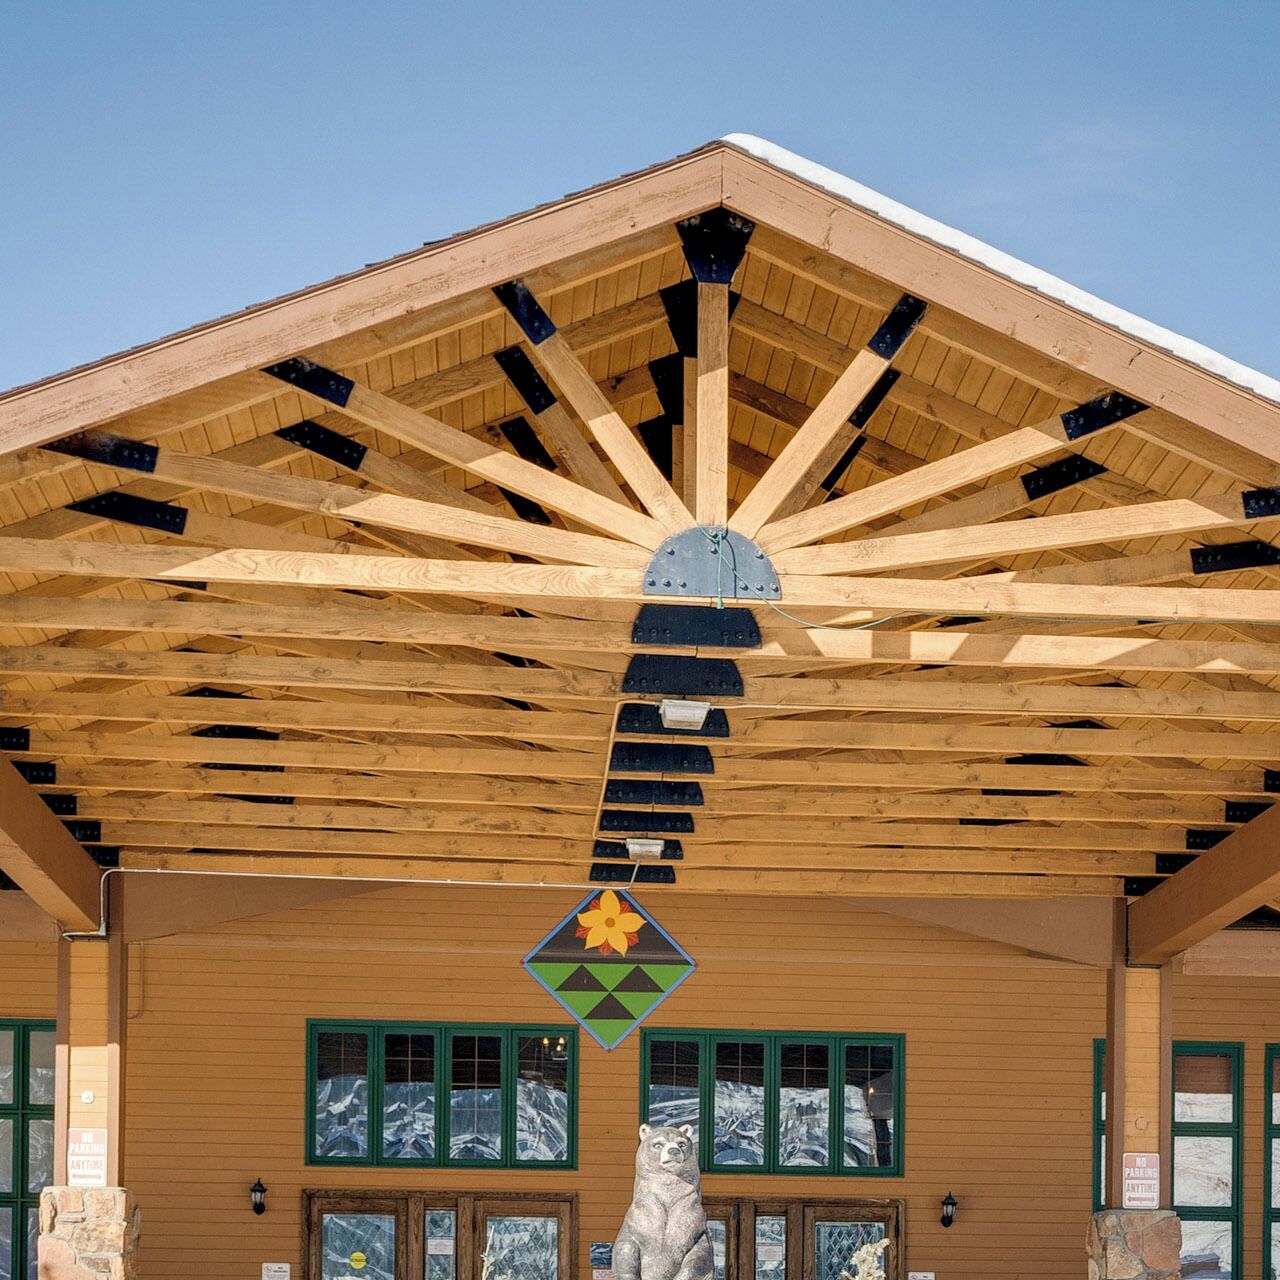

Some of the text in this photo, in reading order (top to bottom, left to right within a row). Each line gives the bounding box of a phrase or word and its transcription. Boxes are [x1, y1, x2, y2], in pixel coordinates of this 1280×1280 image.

[81, 1132, 94, 1144] NO
[70, 1143, 104, 1153] PARKING
[71, 1159, 103, 1170] ANYTIME
[1135, 1156, 1147, 1168] NO
[1125, 1167, 1158, 1178] PARKING
[1126, 1183, 1157, 1193] ANYTIME
